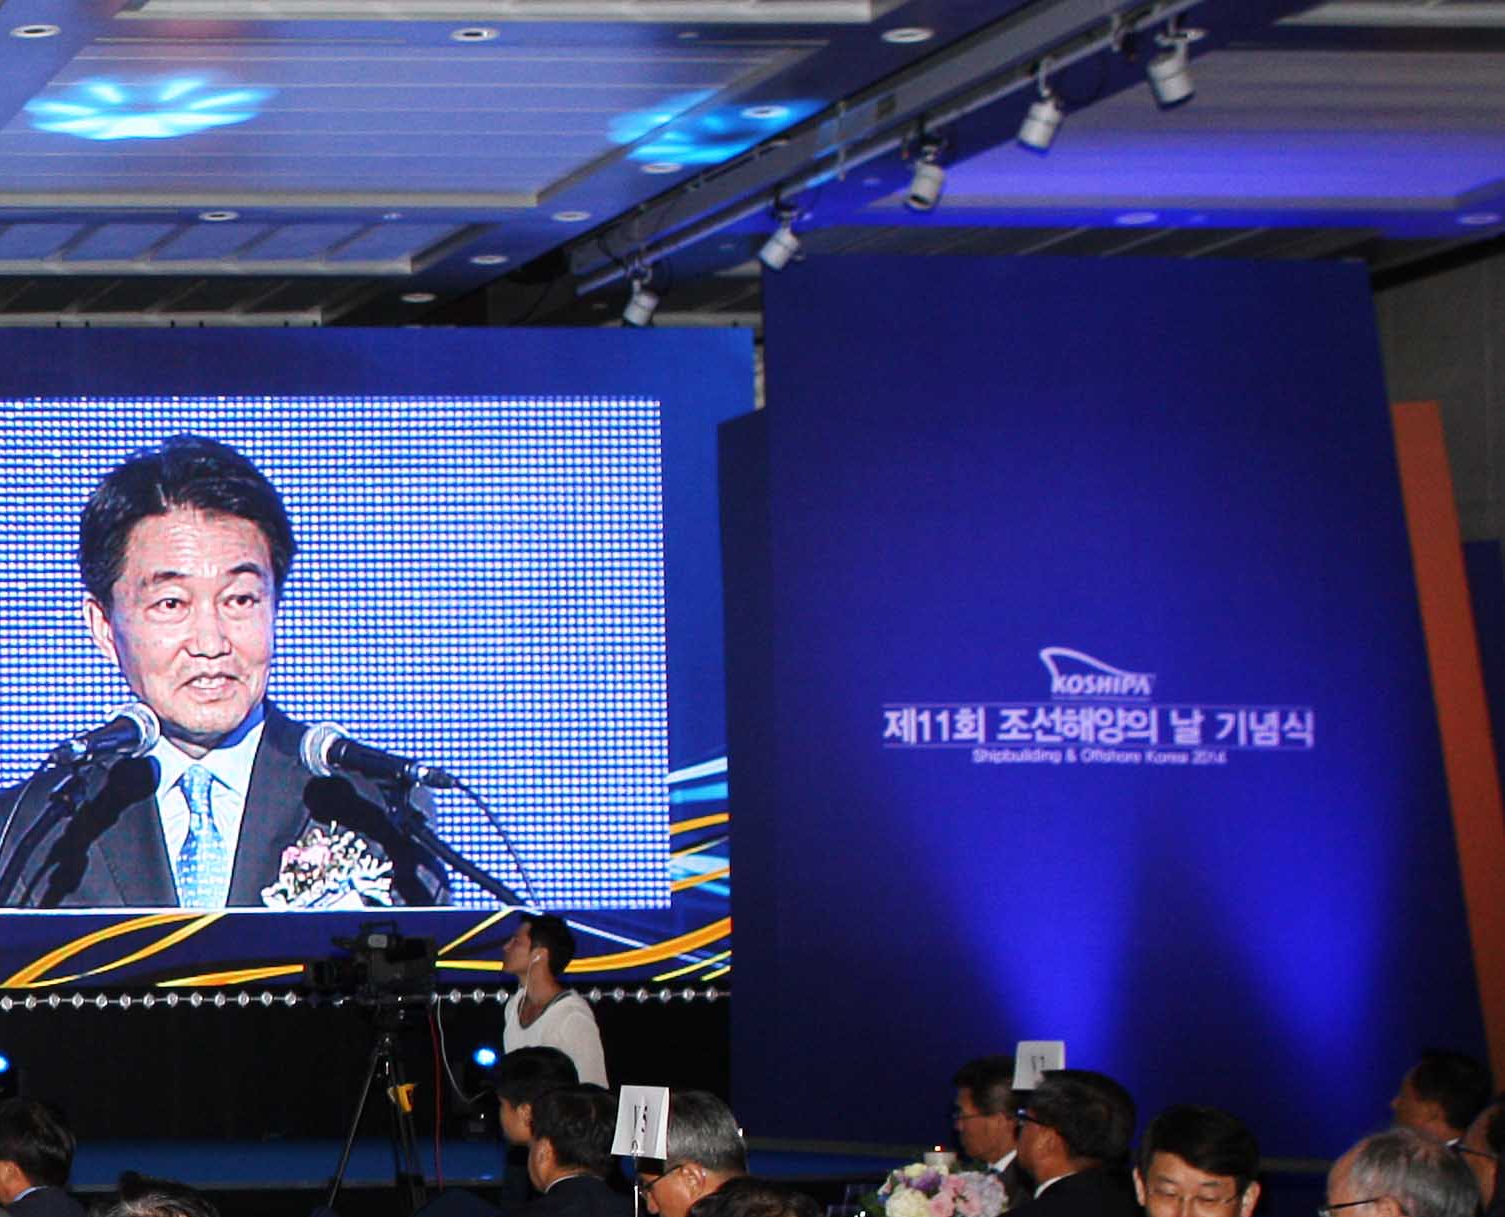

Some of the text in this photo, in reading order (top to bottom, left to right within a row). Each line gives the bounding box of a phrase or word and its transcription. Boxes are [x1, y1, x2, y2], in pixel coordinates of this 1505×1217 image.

[883, 705, 1314, 748] 제11회 조선해양의 날 기념식
